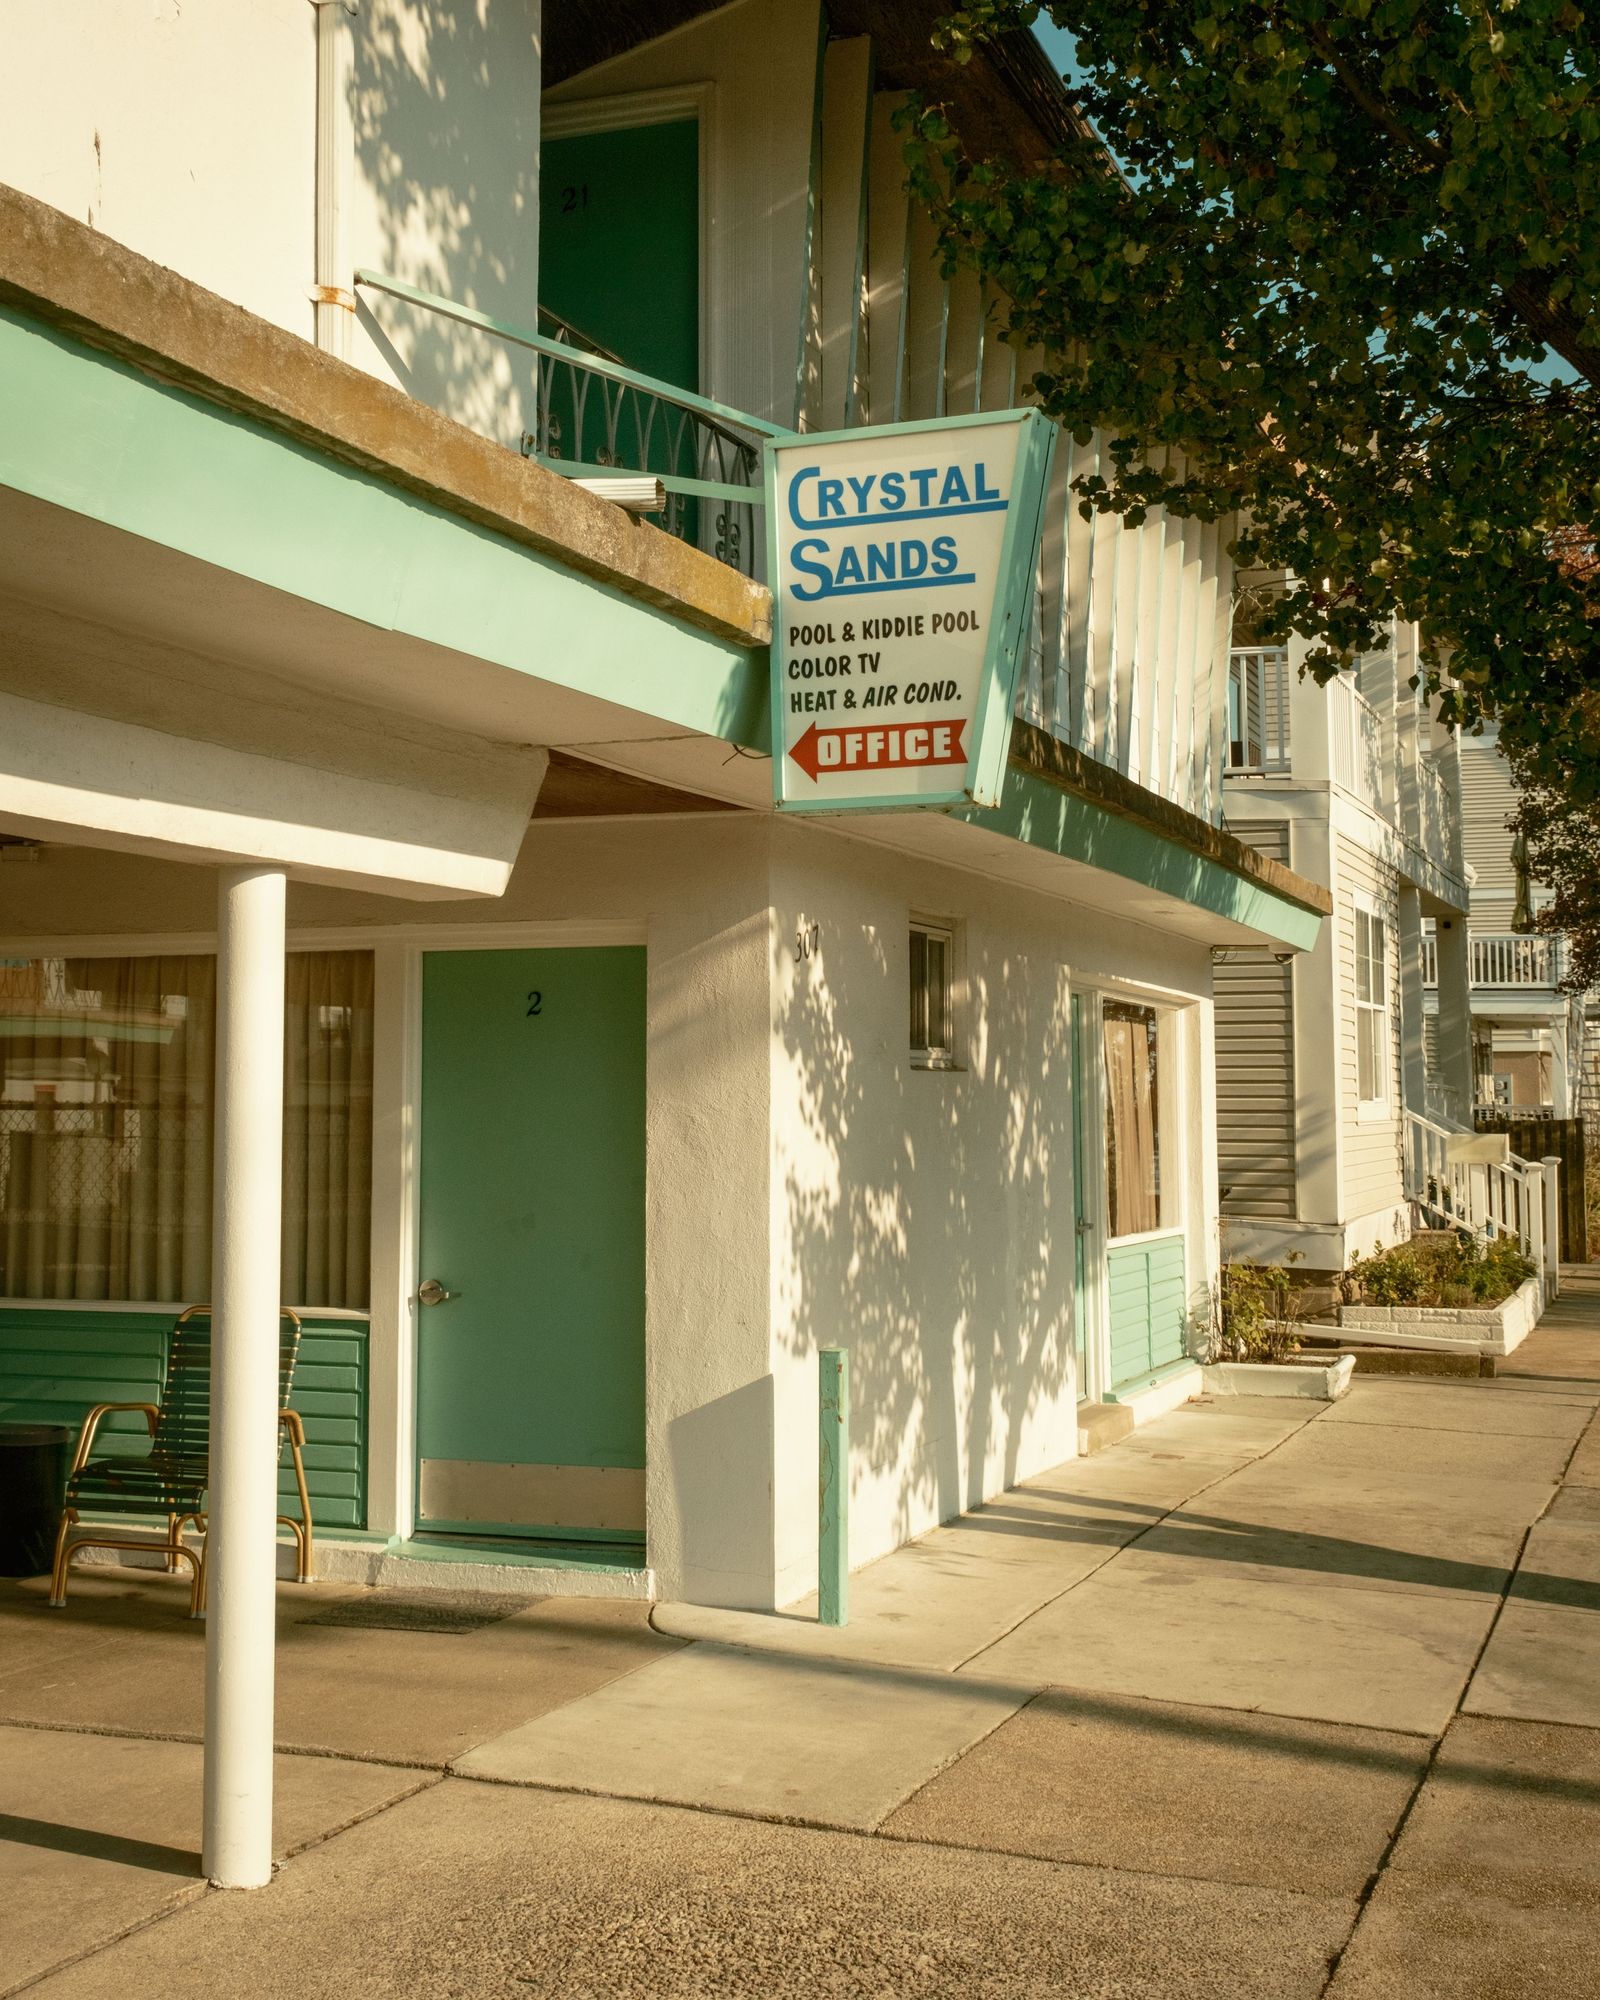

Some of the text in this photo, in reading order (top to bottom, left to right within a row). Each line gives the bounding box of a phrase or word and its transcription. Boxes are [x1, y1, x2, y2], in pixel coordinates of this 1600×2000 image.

[561, 183, 588, 213] 21
[788, 463, 1009, 530] CRYSTAL
[790, 536, 976, 602] SANDS
[789, 610, 980, 647] POOL & KIDDIE POOL
[788, 652, 881, 680] COLOR TV
[790, 680, 962, 713] HEAT & AIR COND.
[817, 727, 951, 766] OFFICE
[795, 924, 819, 963] 307
[526, 991, 543, 1017] 2
